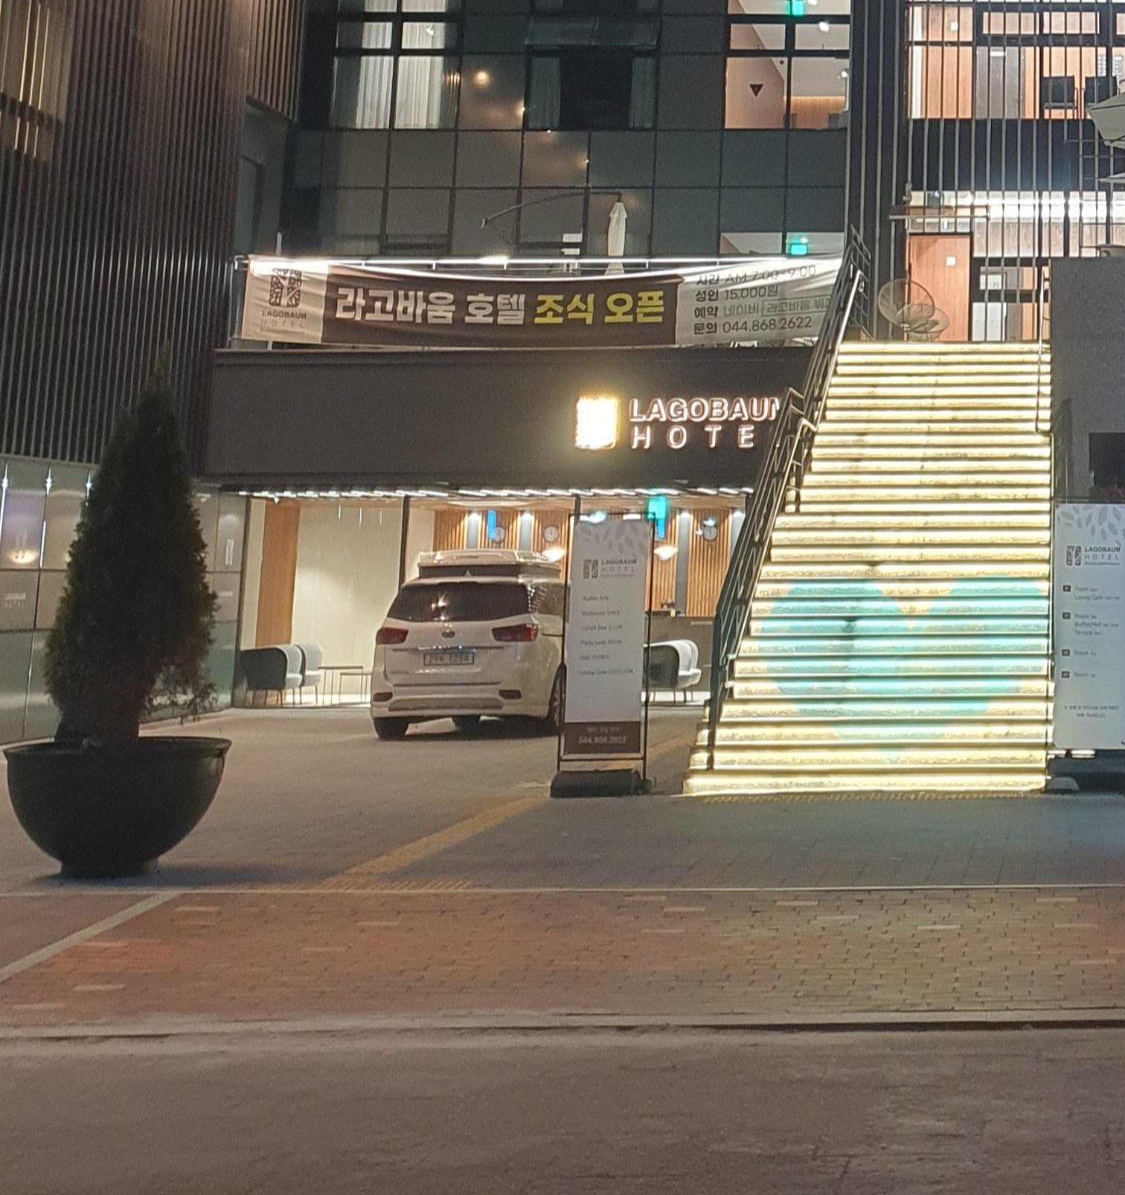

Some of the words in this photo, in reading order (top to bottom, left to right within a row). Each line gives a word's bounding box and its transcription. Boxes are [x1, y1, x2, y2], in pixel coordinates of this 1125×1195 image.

[696, 273, 720, 285] 시간
[725, 272, 747, 284] AM
[695, 289, 719, 303] 성인
[724, 284, 779, 301] 15,000원
[261, 309, 308, 320] LAGOBAUM
[335, 287, 456, 325] 라고바움
[464, 293, 526, 325] 호텔
[534, 293, 595, 325] 조식
[604, 290, 665, 324] 오픈
[694, 305, 719, 319] 예약
[723, 303, 760, 317] 네이버
[767, 299, 810, 313] 라고바움
[260, 318, 305, 329] HOTEL
[693, 321, 718, 335] 문의
[722, 315, 812, 334] 044.868.2622
